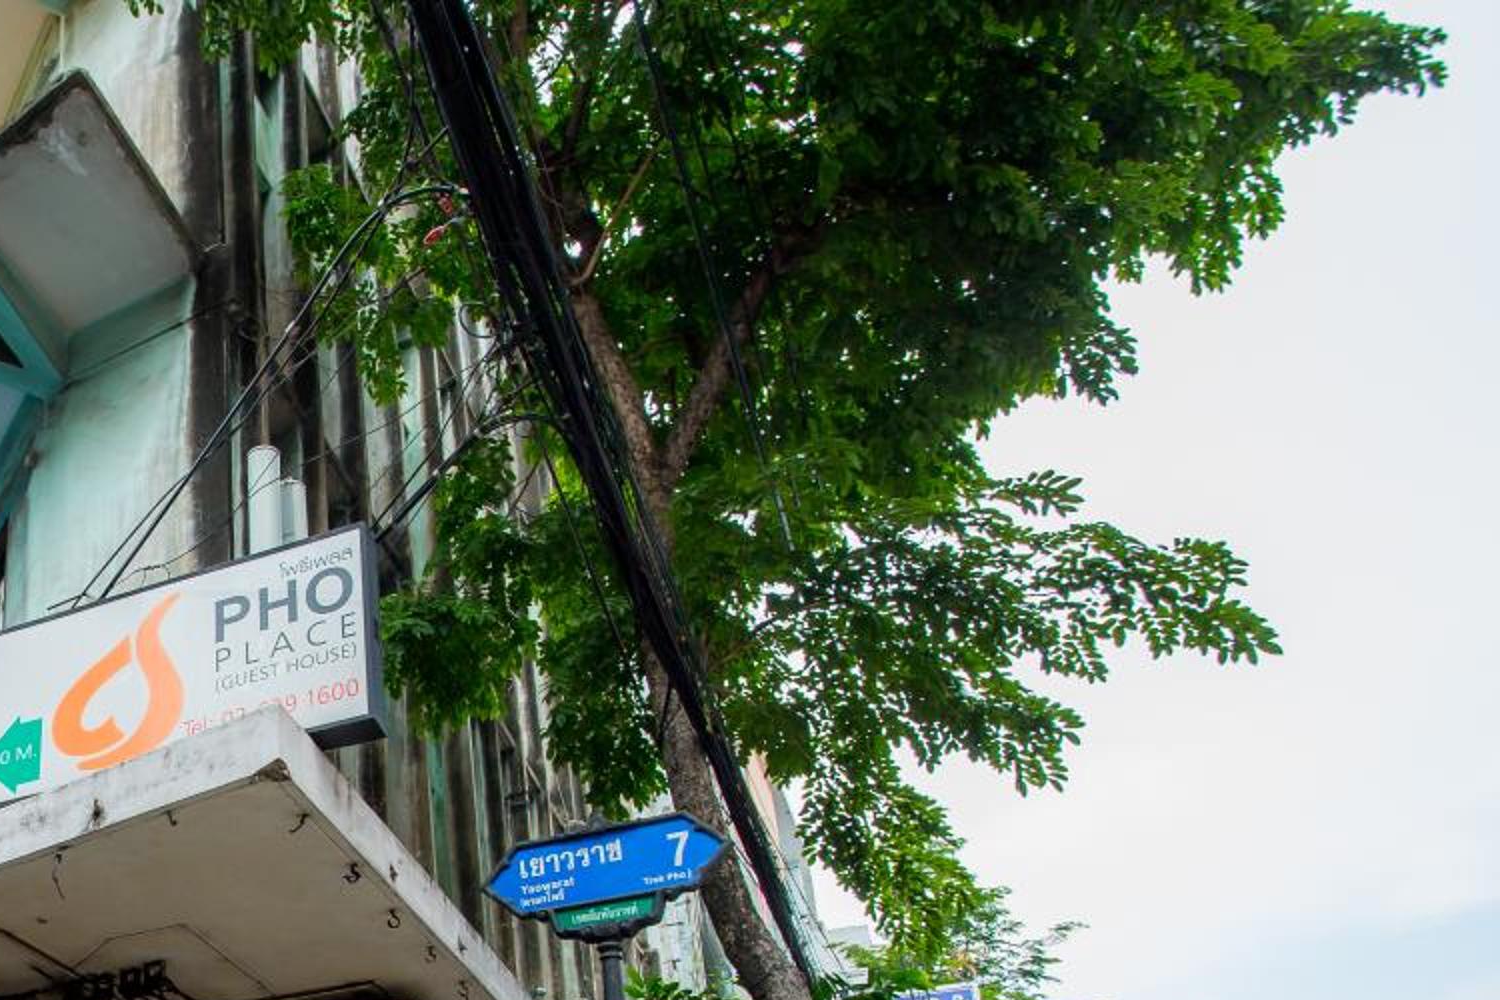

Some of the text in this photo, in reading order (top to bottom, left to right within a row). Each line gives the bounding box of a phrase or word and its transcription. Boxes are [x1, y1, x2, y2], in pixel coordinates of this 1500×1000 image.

[215, 567, 354, 644] PHO
[215, 611, 357, 673] PLACE
[214, 643, 357, 696] (GUEST HOUSE)
[15, 743, 37, 762] M.
[519, 831, 689, 879] เยาวราช 7
